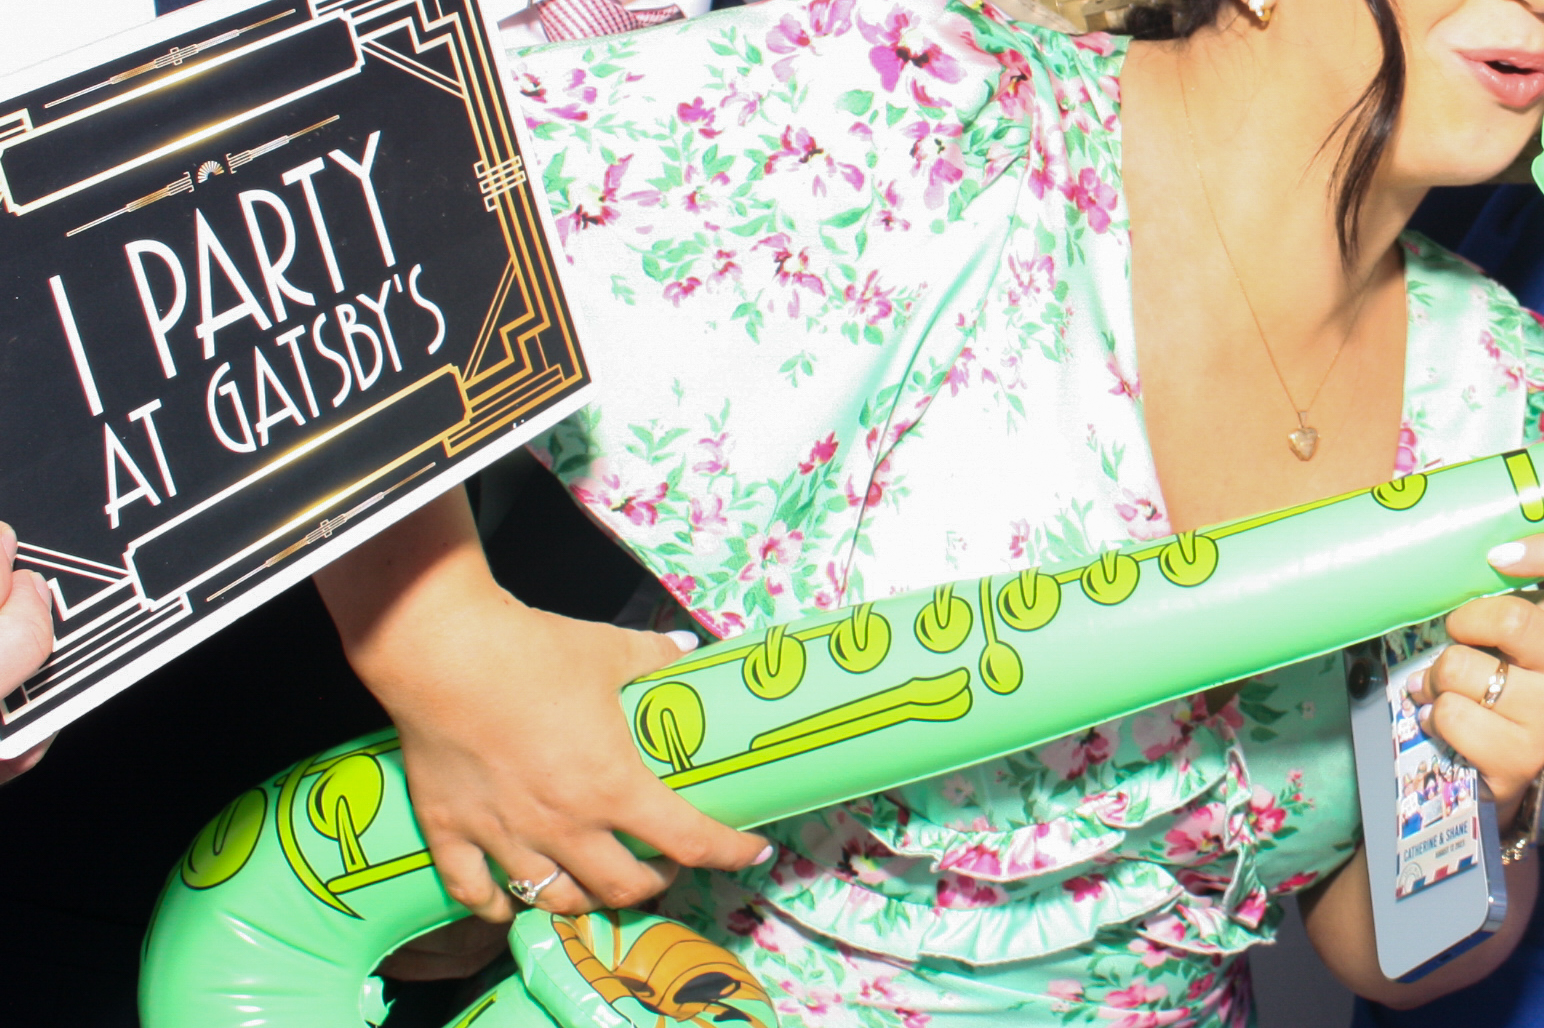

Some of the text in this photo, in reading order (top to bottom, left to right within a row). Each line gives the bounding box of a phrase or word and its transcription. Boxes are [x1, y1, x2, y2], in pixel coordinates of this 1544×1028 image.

[50, 131, 397, 417] I PARTY
[105, 264, 447, 529] AT GATSBY'S
[1404, 834, 1437, 862] CATHERINE
[1446, 820, 1469, 841] SHANE
